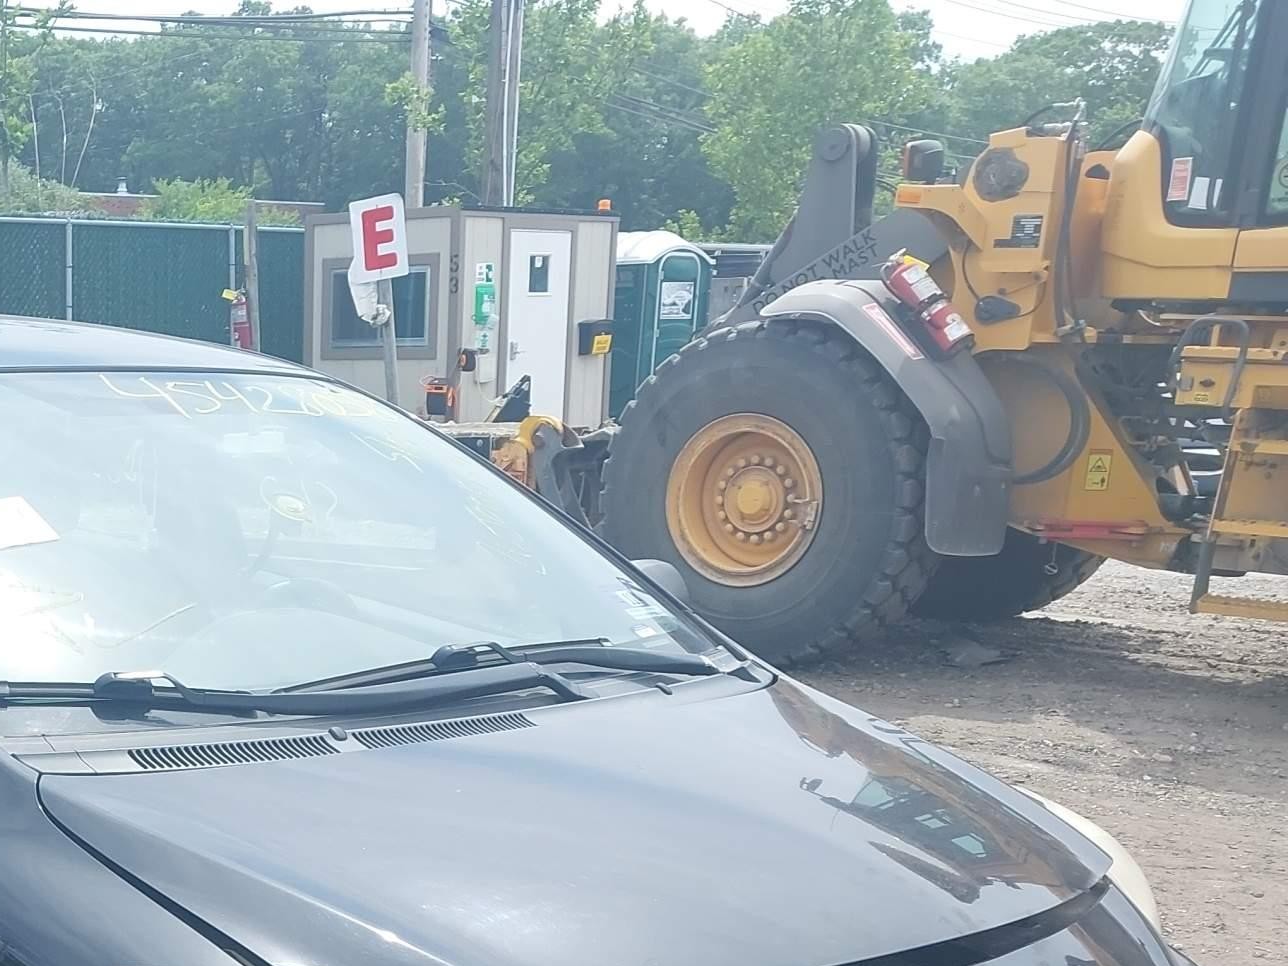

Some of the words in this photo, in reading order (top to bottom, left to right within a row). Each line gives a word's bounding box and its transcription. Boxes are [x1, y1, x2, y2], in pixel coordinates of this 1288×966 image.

[362, 205, 398, 271] E
[822, 230, 877, 268] WALK
[832, 242, 878, 279] MAST
